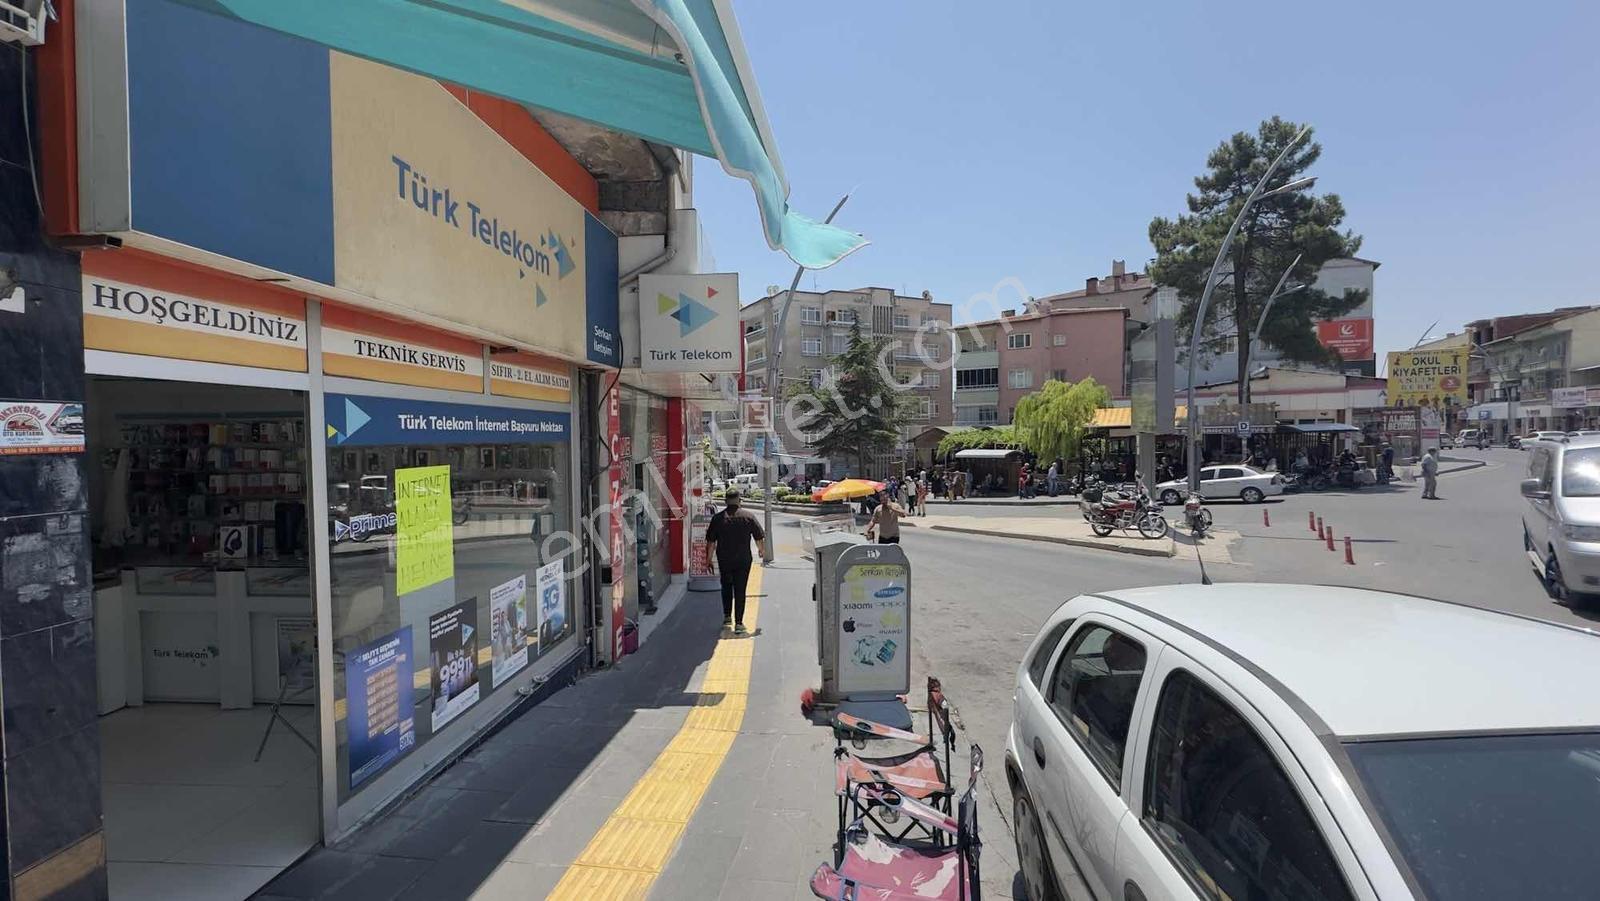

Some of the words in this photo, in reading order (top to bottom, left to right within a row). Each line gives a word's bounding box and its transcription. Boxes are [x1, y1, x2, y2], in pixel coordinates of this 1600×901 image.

[391, 155, 459, 228] Türk
[466, 201, 550, 276] Telekom
[92, 284, 299, 342] HOŞGELDİNİZ
[594, 325, 612, 341] Serkan
[354, 338, 418, 364] TEKNİK
[421, 352, 466, 373] SERVİS
[650, 350, 676, 360] Türk
[682, 349, 732, 360] Telekom
[1412, 357, 1440, 366] OKUL
[491, 364, 512, 378] SIFIR
[525, 371, 533, 382] EL
[535, 373, 550, 385] ALIM
[397, 414, 427, 430] Türk
[429, 416, 473, 431] Telekom
[476, 416, 509, 432] İnternet
[511, 420, 539, 434] Başvuru
[350, 512, 397, 539] prime
[843, 602, 872, 610] xiaomi
